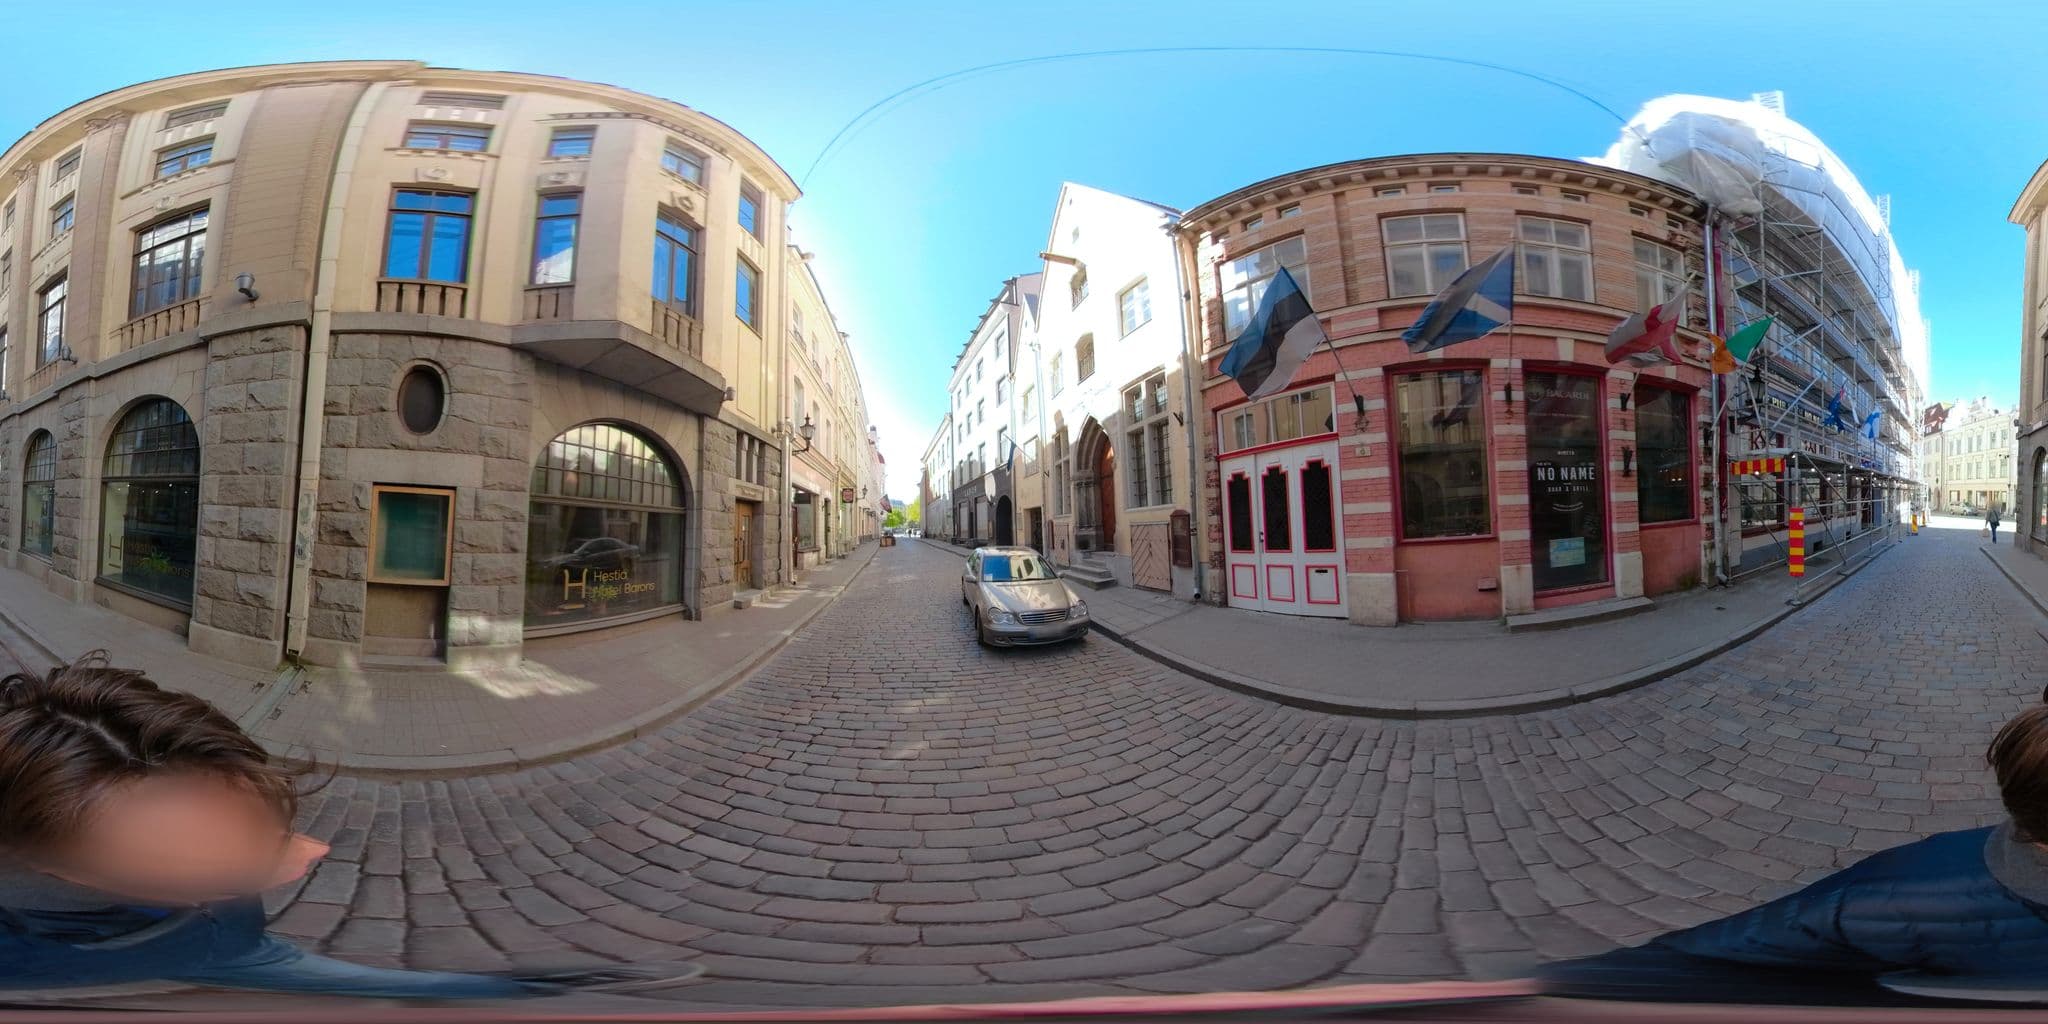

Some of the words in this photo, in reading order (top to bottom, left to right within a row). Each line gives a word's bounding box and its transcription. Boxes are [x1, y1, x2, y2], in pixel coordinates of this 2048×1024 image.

[1537, 466, 1555, 481] NO
[1560, 466, 1596, 481] NAME
[593, 569, 628, 582] Hestia
[624, 581, 656, 595] Barons
